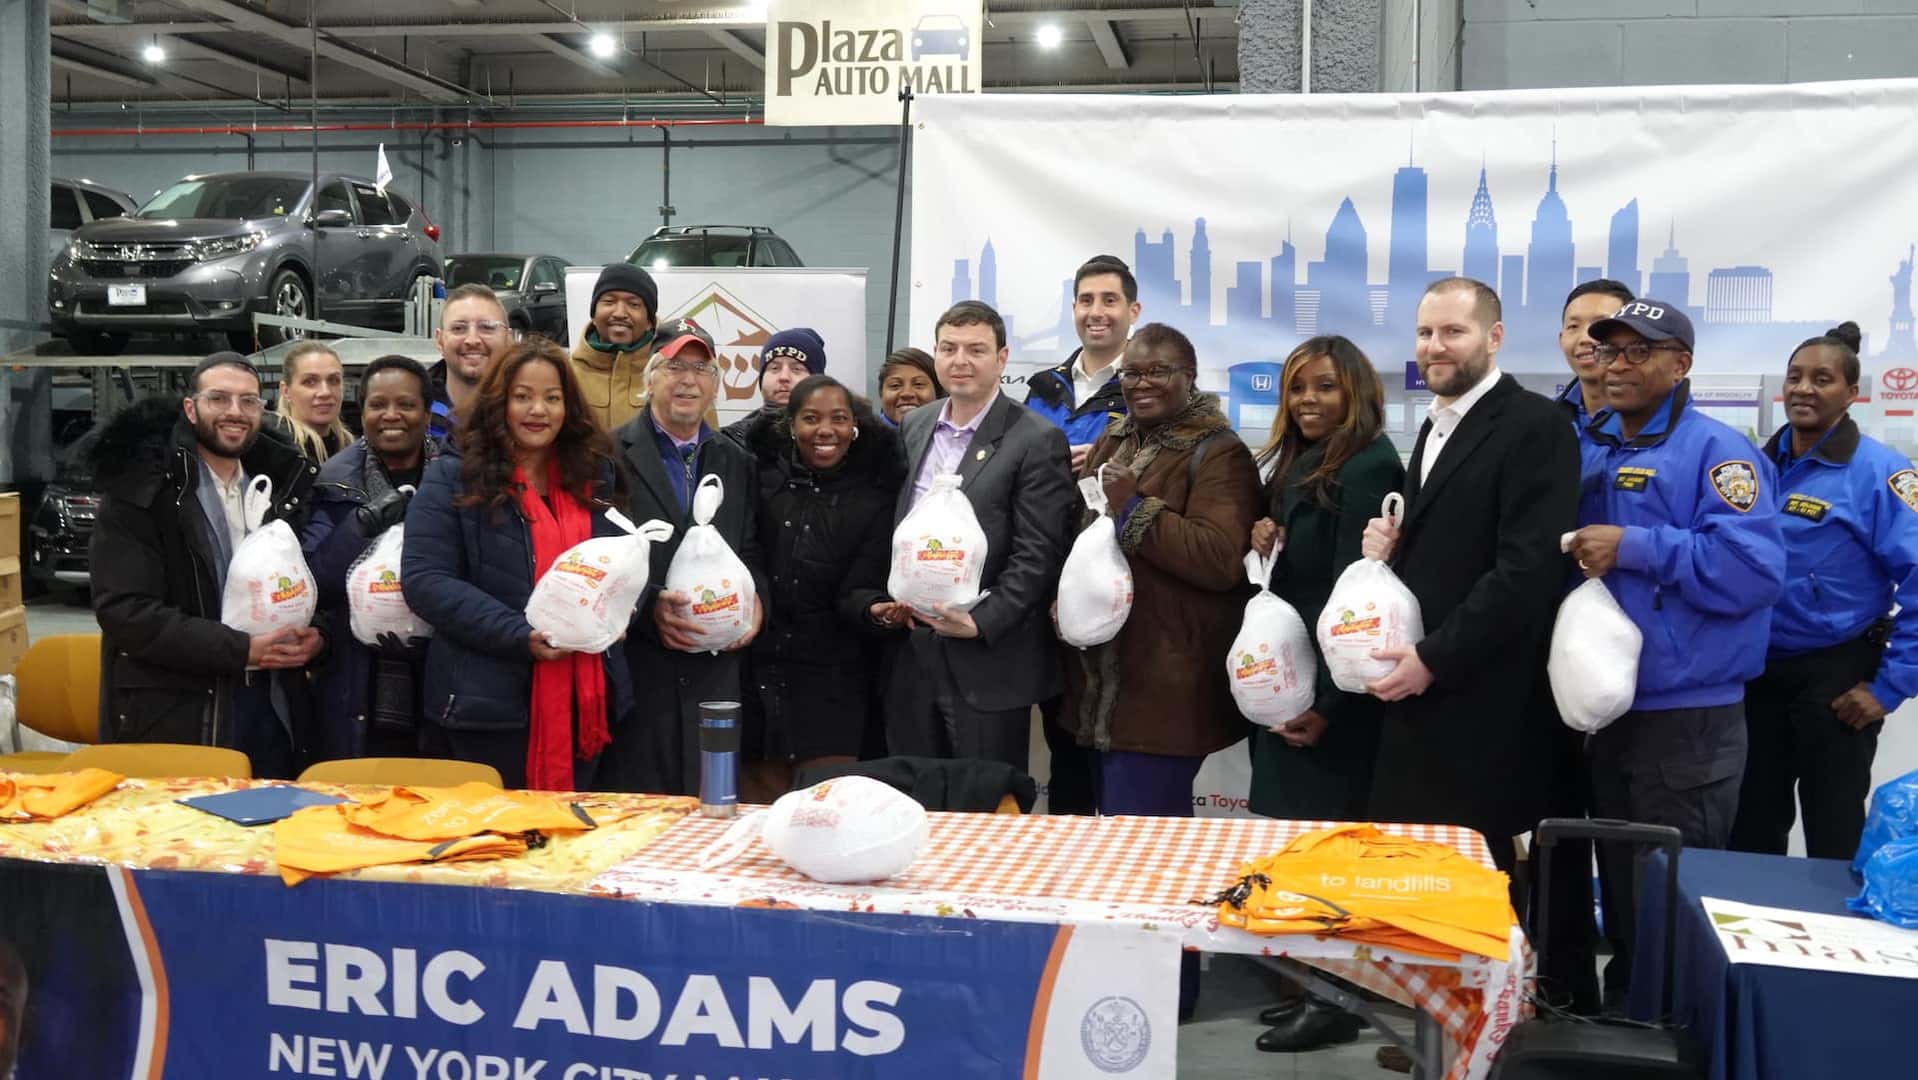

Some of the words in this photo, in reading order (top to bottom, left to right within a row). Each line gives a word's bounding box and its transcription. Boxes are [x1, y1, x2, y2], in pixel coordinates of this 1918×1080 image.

[776, 20, 904, 97] Plaza
[814, 66, 890, 96] AUTO
[899, 65, 976, 94] MALL
[1611, 302, 1665, 320] YPD
[764, 346, 807, 362] NYPD
[1209, 794, 1249, 812] Toyo
[1320, 873, 1346, 888] to
[264, 938, 487, 1025] ERIC
[512, 959, 905, 1056] ADAMS
[269, 1033, 393, 1080] NEW
[405, 1046, 548, 1080] YORK
